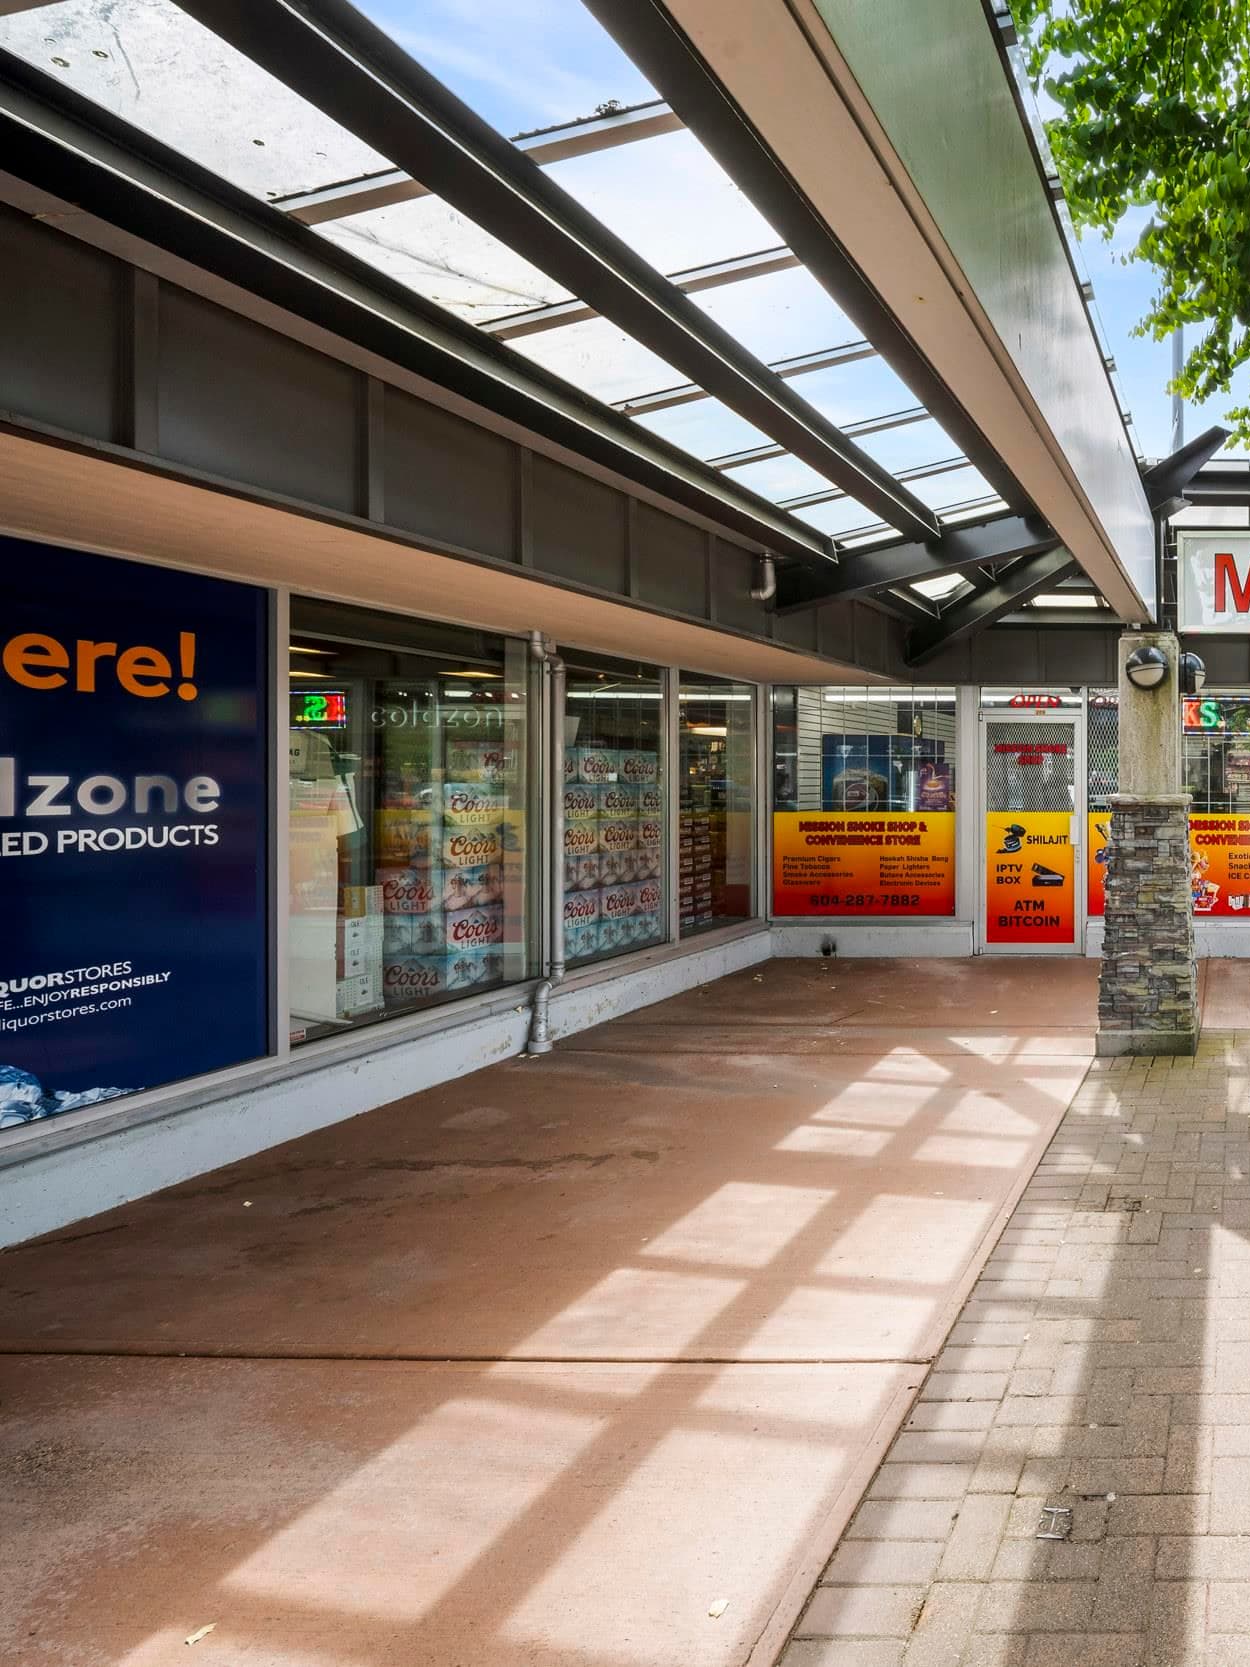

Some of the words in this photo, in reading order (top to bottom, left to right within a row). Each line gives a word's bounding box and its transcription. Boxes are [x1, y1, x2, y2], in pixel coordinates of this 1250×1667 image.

[2, 631, 198, 701] ere!
[451, 793, 498, 813] Coors
[565, 792, 595, 809] Coors
[605, 792, 635, 808] Coors
[460, 813, 492, 823] LIGHT
[799, 821, 845, 832] MISSION
[847, 822, 885, 832] SMOKE
[887, 822, 917, 832] SHOP
[919, 822, 928, 832] &
[0, 831, 49, 856] ED
[57, 824, 219, 853] PRODUCTS
[565, 828, 594, 846] Coors
[604, 826, 634, 842] Coors
[885, 835, 920, 845] STORE
[1026, 835, 1068, 845] SHILAJIT
[450, 835, 497, 856] Coors
[568, 846, 589, 854] LIGHT
[459, 855, 490, 865] LIGHT
[996, 864, 1023, 872] IPTV
[996, 876, 1021, 884] BOX
[382, 879, 435, 900] Coors
[390, 901, 426, 910] LIGHT
[607, 894, 635, 911] Coors
[1014, 900, 1045, 911] ATM
[564, 901, 595, 920] Coors
[567, 917, 590, 927] LIGHT
[999, 916, 1060, 927] BITCOIN
[453, 919, 498, 940] Coors
[461, 936, 490, 949] LIGHT
[384, 965, 441, 986] Coors
[393, 986, 431, 997] LIGHT
